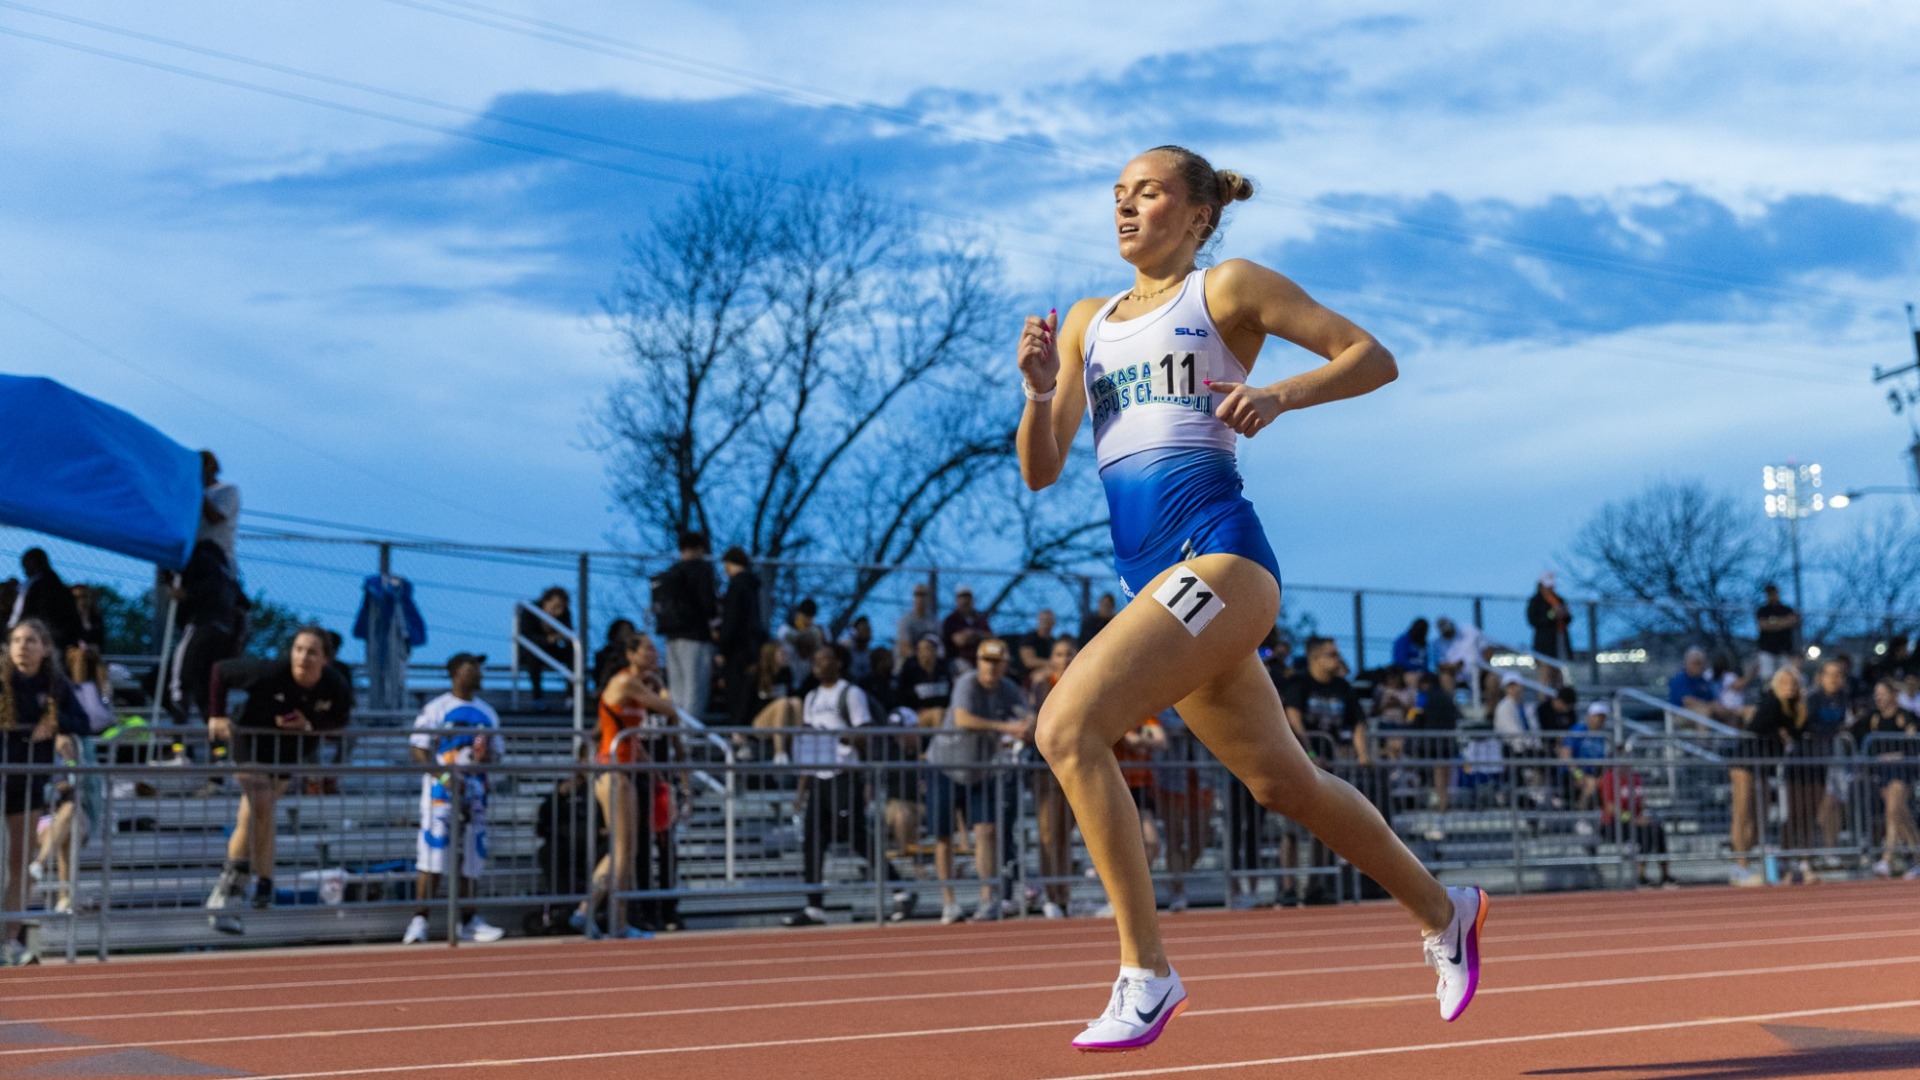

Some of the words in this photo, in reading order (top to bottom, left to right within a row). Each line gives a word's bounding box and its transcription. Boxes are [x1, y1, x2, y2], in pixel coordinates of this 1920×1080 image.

[1090, 364, 1138, 402] TEXAS
[1159, 353, 1195, 395] 11
[1092, 385, 1131, 433] RPUS
[1166, 575, 1214, 625] 11
